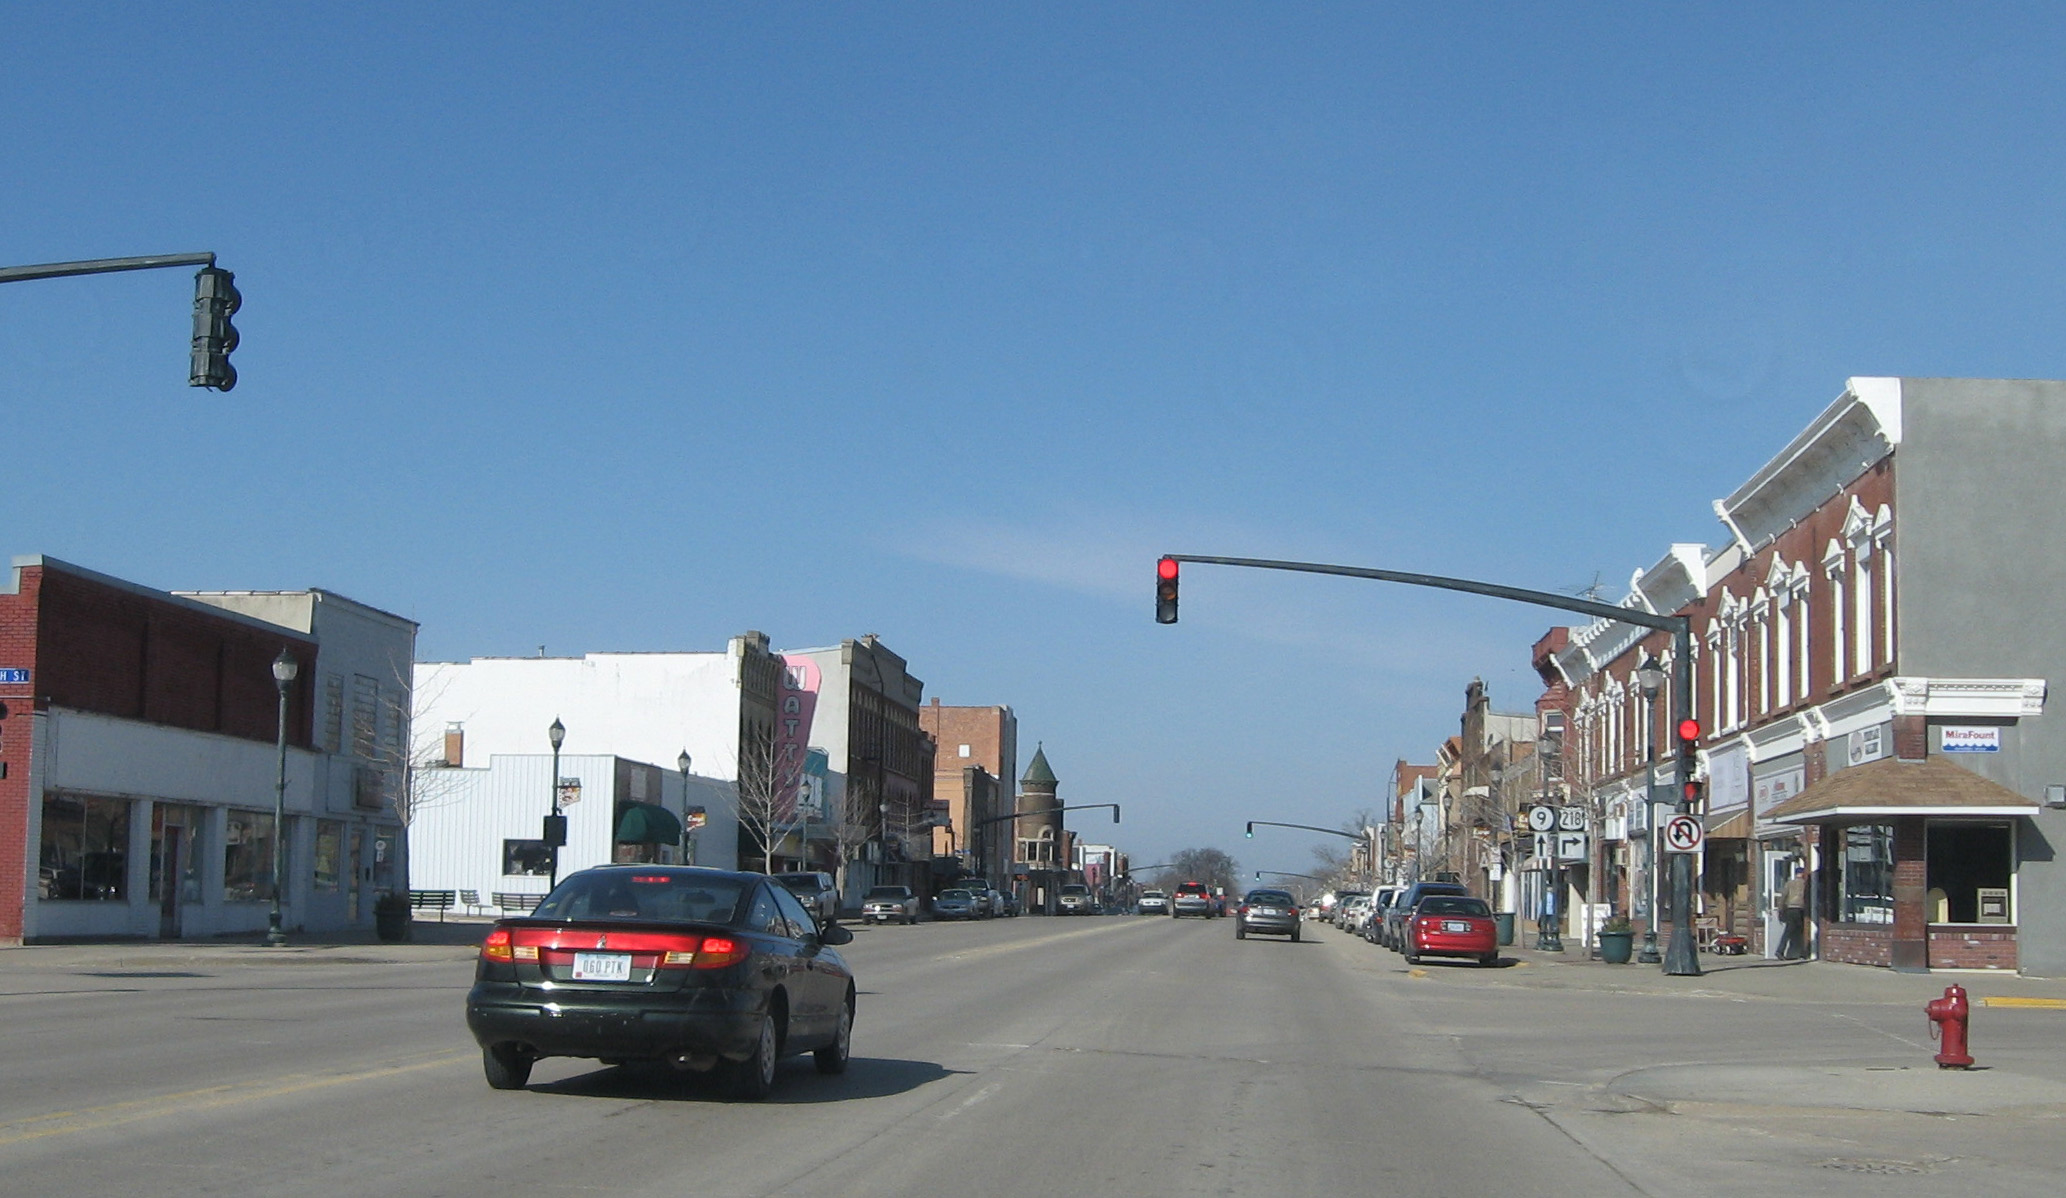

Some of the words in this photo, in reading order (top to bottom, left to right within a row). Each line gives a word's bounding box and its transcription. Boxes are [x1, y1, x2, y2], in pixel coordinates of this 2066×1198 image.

[13, 670, 26, 681] ST
[1945, 730, 1995, 739] MiraFount
[1536, 811, 1546, 826] 9
[1561, 811, 1581, 826] 218
